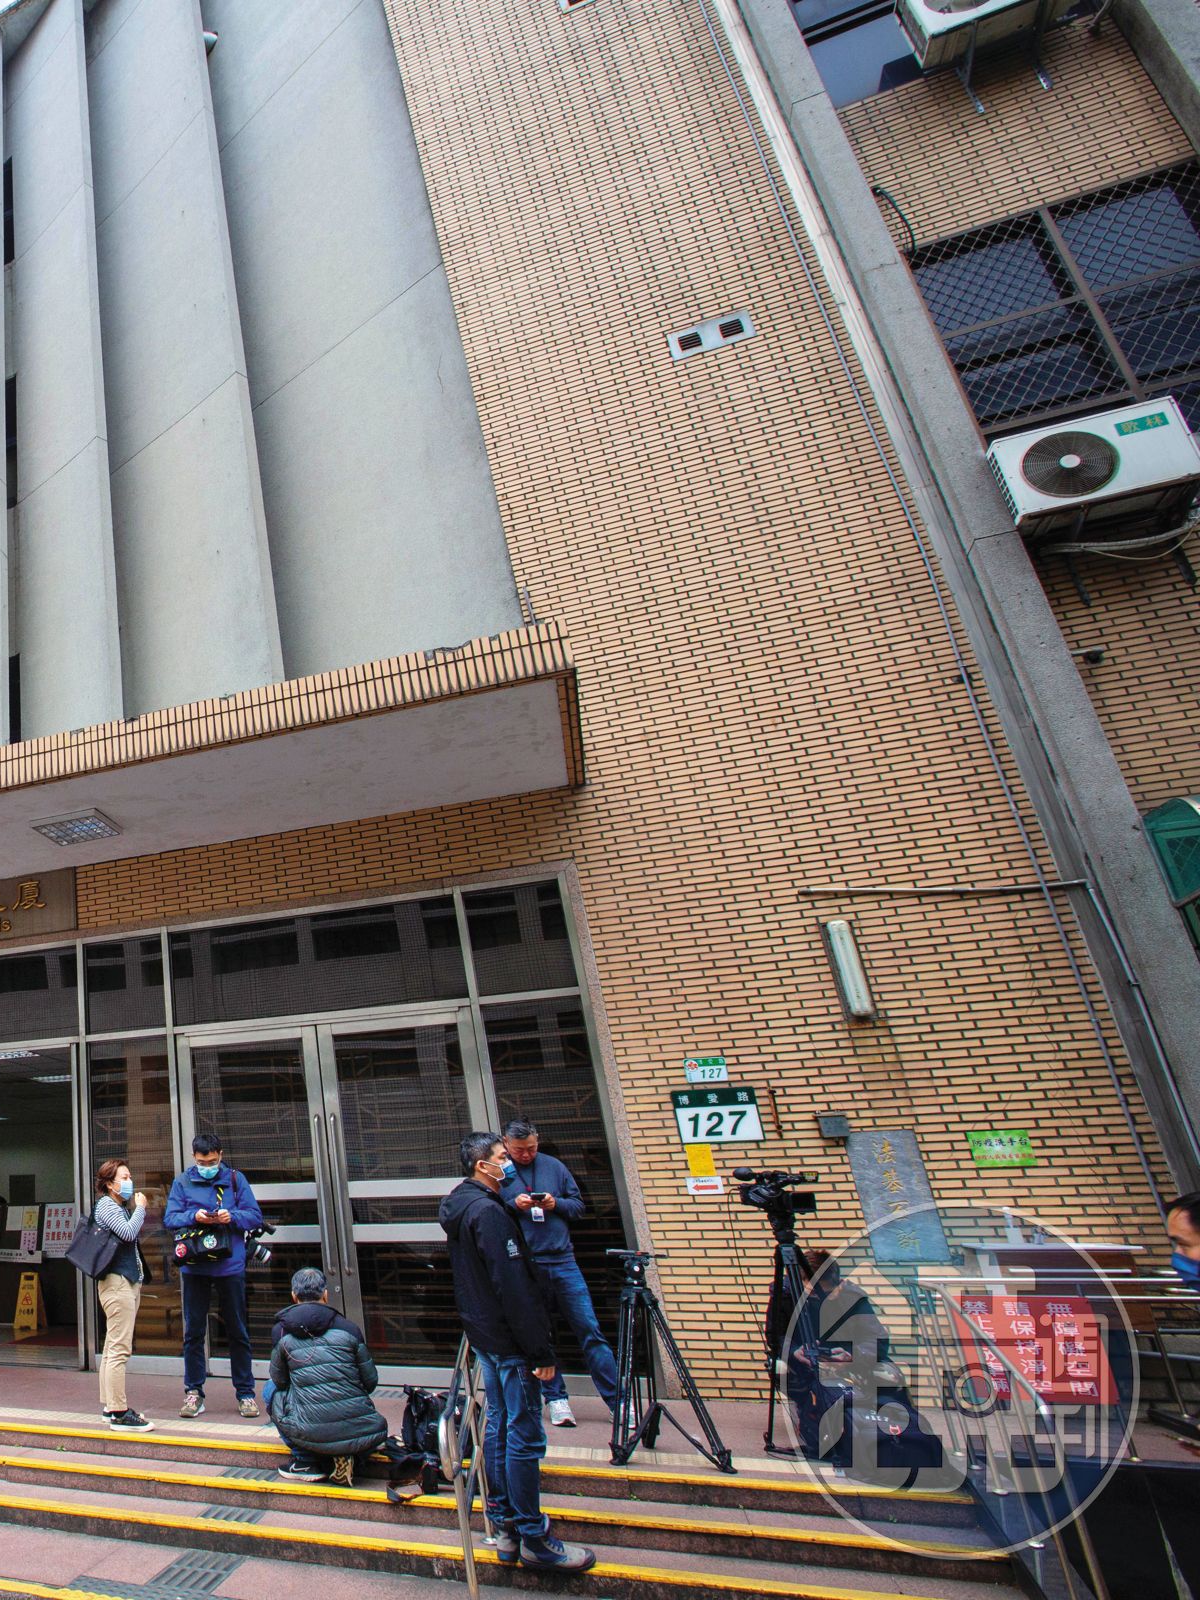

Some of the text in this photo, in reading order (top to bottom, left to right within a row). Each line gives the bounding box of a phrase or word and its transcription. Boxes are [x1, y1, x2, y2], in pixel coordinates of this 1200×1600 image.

[700, 1068, 722, 1079] 127
[678, 1091, 749, 1105] 博愛路
[688, 1110, 747, 1137] 127
